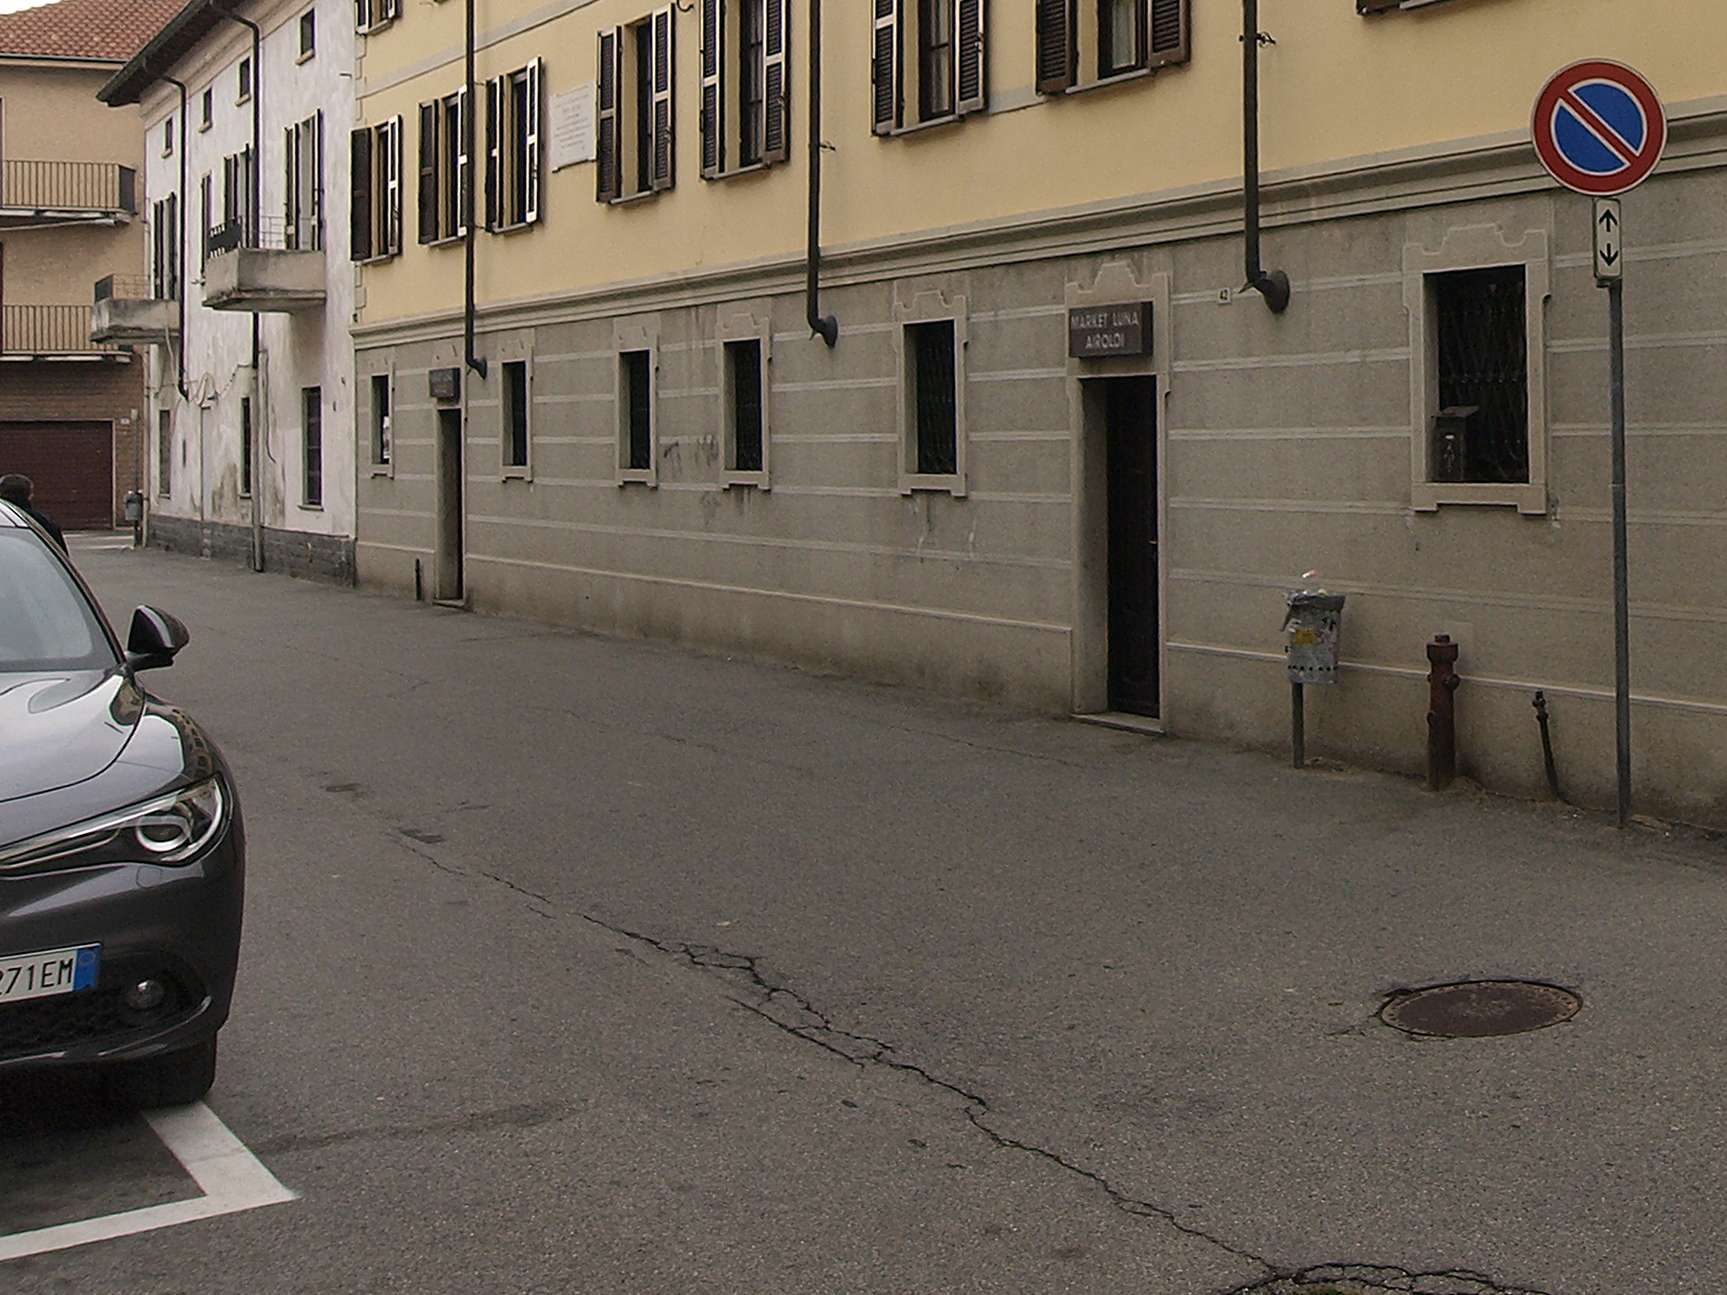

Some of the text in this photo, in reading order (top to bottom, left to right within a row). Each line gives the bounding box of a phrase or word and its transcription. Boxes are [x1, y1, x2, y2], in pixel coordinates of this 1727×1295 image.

[1070, 311, 1140, 329] MARKET LUNA
[1085, 332, 1126, 350] AIROLDI
